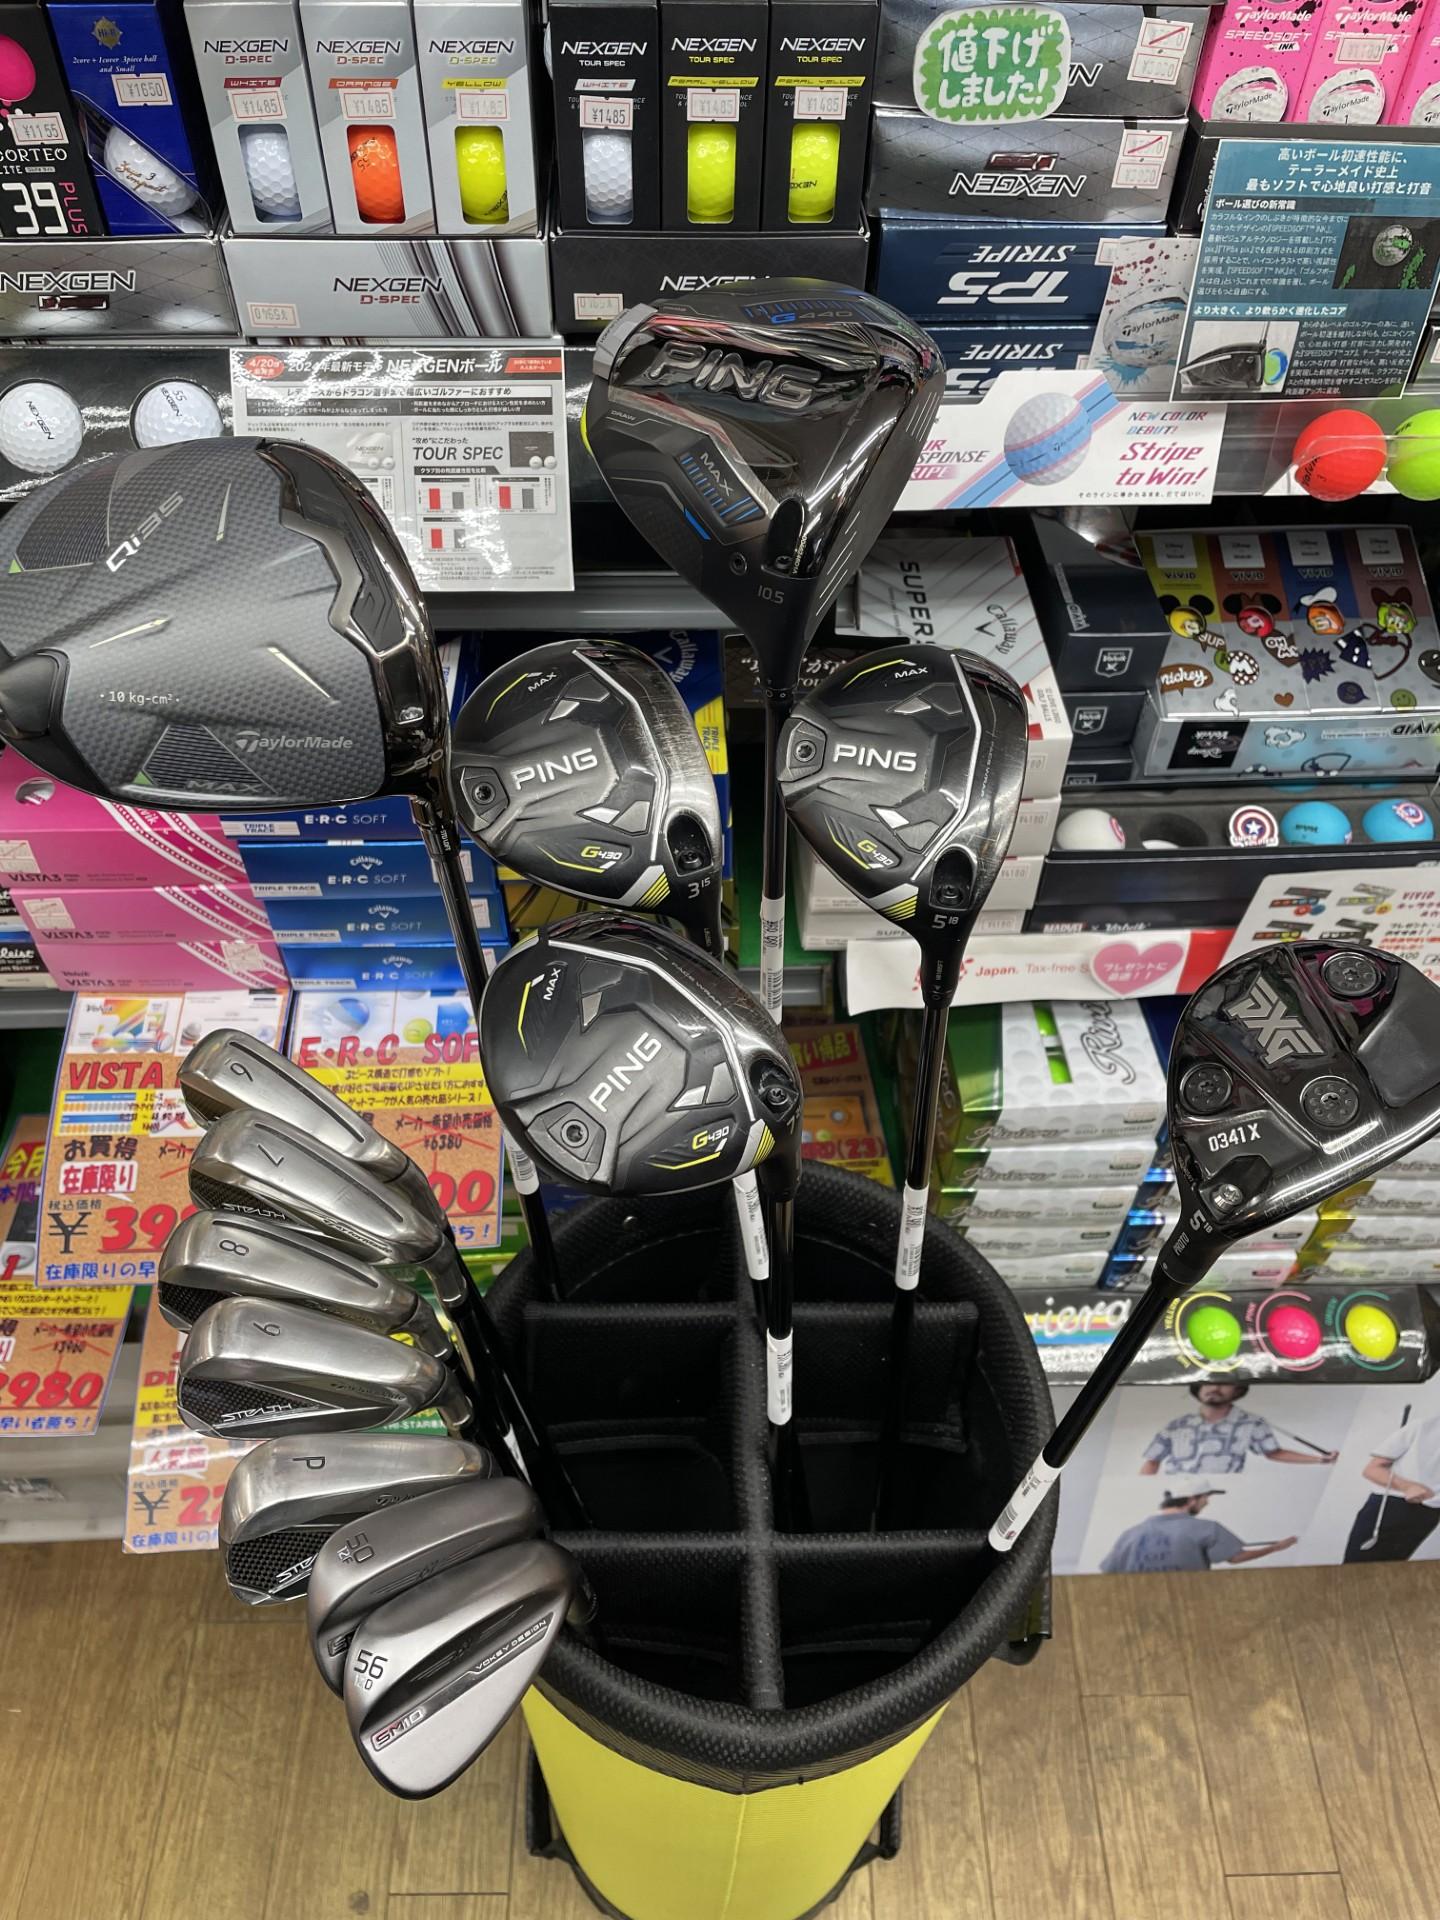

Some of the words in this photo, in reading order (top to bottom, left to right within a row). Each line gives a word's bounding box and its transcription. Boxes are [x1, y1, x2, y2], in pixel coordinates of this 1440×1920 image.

[1235, 6, 1312, 23] TaylorMade
[1335, 7, 1412, 24] TaylorMade
[1224, 30, 1312, 41] SPEEDSOFT
[204, 40, 288, 54] NEXGEN
[316, 40, 401, 55] NEXGEN
[429, 40, 514, 55] NEXGEN
[562, 42, 647, 55] NEXGEN
[671, 38, 757, 52] NEXGEN
[780, 38, 866, 52] NEXGEN
[938, 23, 1054, 73] 値下げ
[225, 55, 273, 65] D-SPEC
[336, 55, 384, 65] D-SPEC
[449, 55, 497, 65] D-SPEC
[126, 83, 163, 97] ¥1650
[229, 79, 277, 87] WHITE
[336, 79, 392, 88] ORANGE
[447, 79, 503, 87] YELLOW
[243, 97, 280, 113] ¥1485
[353, 96, 389, 113] ¥1485
[700, 100, 733, 114] ¥1485
[806, 97, 839, 112] ¥1485
[1225, 93, 1273, 113] TaylorMade
[1323, 95, 1370, 116] TaylorMade
[592, 108, 625, 124] ¥1485
[23, 124, 59, 138] ¥1155
[1278, 148, 1408, 163] 高いボール初速性能に、
[1288, 165, 1399, 178] テーラーメイド史上
[950, 173, 1086, 196] NEXGEN
[1246, 179, 1432, 195] 最もソフトで心地良い打感と打音
[3, 182, 59, 235] 39
[59, 182, 89, 234] PLUS
[968, 245, 1076, 263] STRIPE
[1, 271, 136, 293] NEXGEN
[333, 277, 443, 293] NEXGEN
[937, 271, 1069, 304] TP5
[360, 294, 420, 304] D-SPEC
[1121, 313, 1180, 337] TaylorMade
[960, 344, 1064, 360] STRIPE
[644, 340, 823, 410] PING
[611, 409, 637, 421] DRAW
[1128, 411, 1158, 422] NEW
[1161, 411, 1208, 422] COLOR
[1126, 426, 1179, 436] DEBUT!
[413, 447, 457, 460] TOUR
[463, 447, 504, 459] SPEC
[918, 451, 990, 464] SPONSE
[1120, 442, 1204, 463] Stripe
[700, 452, 735, 497] MAX
[1115, 468, 1143, 486] to
[1145, 467, 1209, 486] Win!
[106, 491, 184, 572] Qi35
[1165, 572, 1196, 580] VIVID
[1230, 572, 1264, 580] VIVID
[1298, 568, 1333, 577] VIVID
[1369, 568, 1404, 576] VIVID
[757, 585, 785, 604] 10.5
[900, 561, 936, 645] SUPER
[987, 604, 1018, 655] Callaway
[894, 666, 928, 679] MAX
[527, 671, 557, 692] MAX
[109, 691, 125, 702] 10
[235, 730, 353, 752] TaylorMade
[832, 743, 917, 772] PING
[510, 748, 598, 790] PING
[187, 780, 268, 793] MAX
[353, 815, 388, 824] SOFT
[350, 856, 383, 866] Callaway
[581, 845, 623, 861] G430
[856, 839, 893, 867] G430
[374, 875, 407, 884] SOFT
[687, 882, 700, 899] 3
[701, 877, 711, 888] 15
[1403, 892, 1435, 900] VIVID
[368, 905, 399, 914] Callaway
[391, 922, 422, 931] SOFT
[932, 915, 947, 928] 5
[948, 916, 958, 925] 18
[383, 956, 413, 965] Callaway
[975, 965, 1020, 977] Japan.
[1026, 963, 1077, 973] Tax-free
[543, 967, 561, 1000] MAX
[1229, 976, 1325, 1065] PXG
[69, 1062, 163, 1090] VISTA
[229, 1062, 254, 1082] 6
[588, 1032, 662, 1113] PING
[423, 1134, 462, 1151] ¥6380
[692, 1126, 730, 1150] G430
[1209, 1127, 1246, 1153] 0341
[1247, 1124, 1261, 1141] X
[64, 1134, 138, 1161] お買得
[257, 1144, 284, 1168] 7
[62, 1164, 134, 1193] 在庫限り
[49, 1200, 102, 1210] 税込価格
[221, 1203, 286, 1220] STEALTH
[1190, 1210, 1206, 1233] 5
[1202, 1221, 1213, 1233] 18
[49, 1212, 91, 1254] ¥
[219, 1239, 249, 1257] 8
[1173, 1232, 1190, 1256] PROTO
[46, 1262, 156, 1281] 在庫限りの早
[253, 1322, 281, 1338] 9
[221, 1402, 292, 1423] STEALTH
[293, 1456, 326, 1470] P
[134, 1489, 172, 1526] ¥
[346, 1532, 375, 1565] 50
[475, 1643, 511, 1671] VOKEY
[511, 1619, 547, 1648] DESIGN
[354, 1650, 388, 1679] 56
[373, 1708, 425, 1749] SM10
